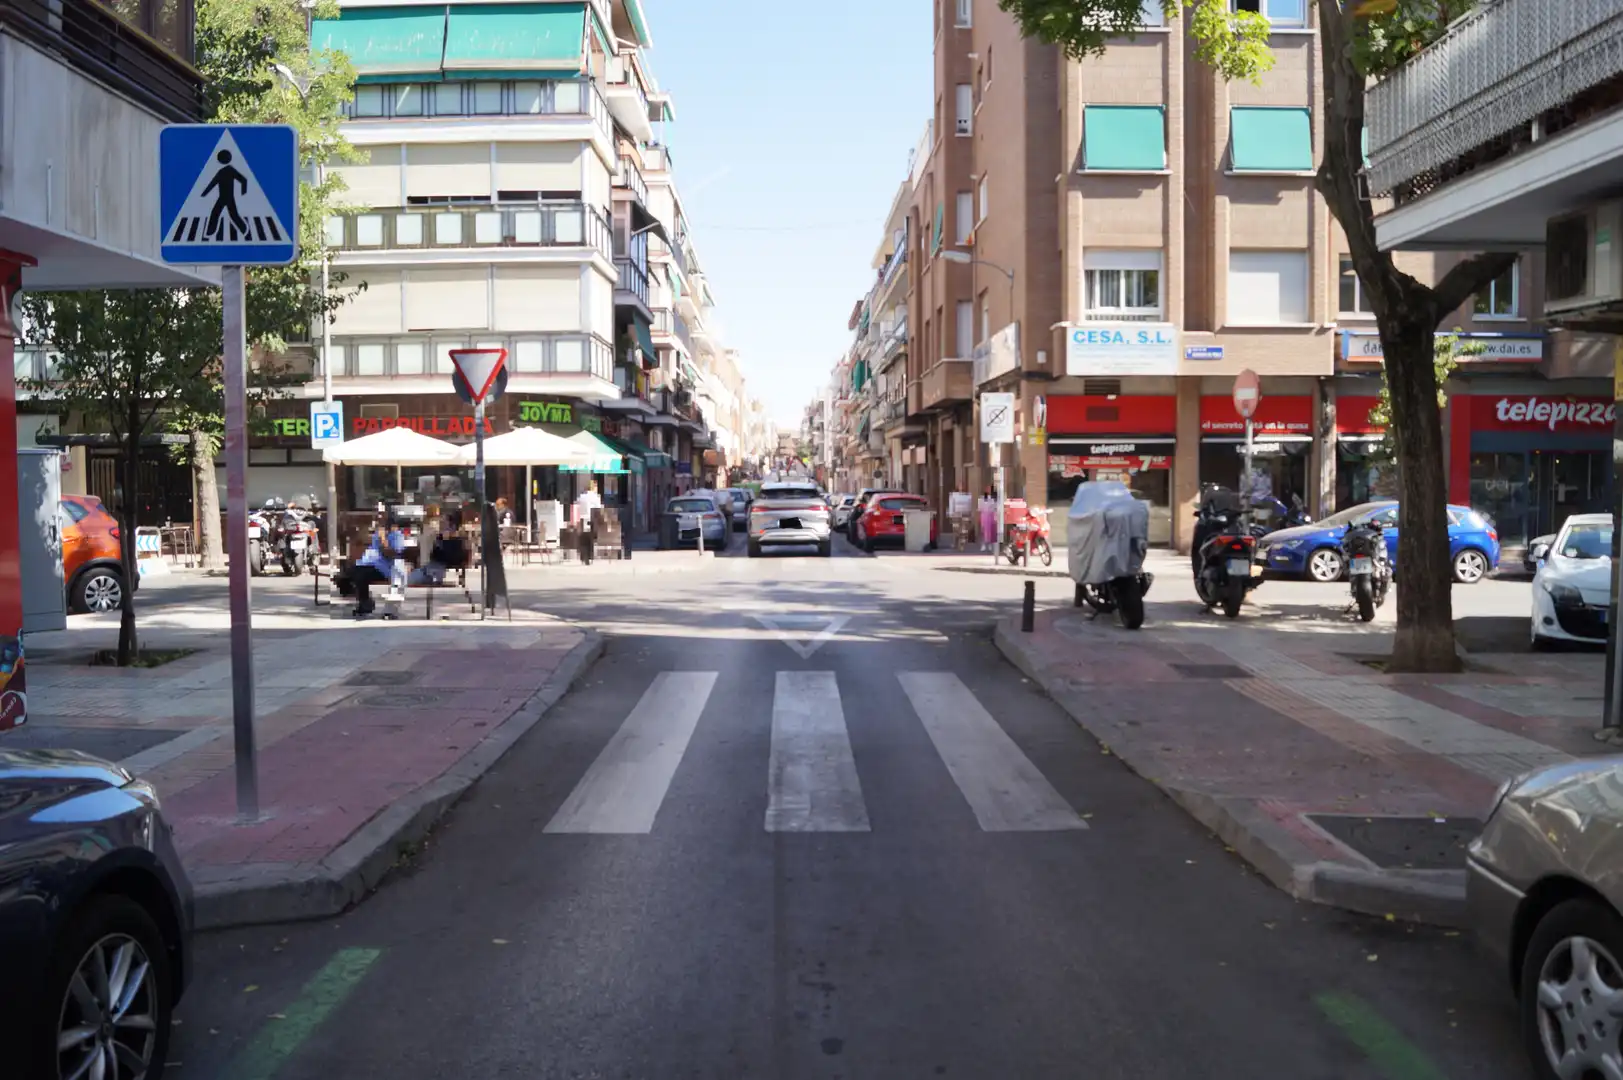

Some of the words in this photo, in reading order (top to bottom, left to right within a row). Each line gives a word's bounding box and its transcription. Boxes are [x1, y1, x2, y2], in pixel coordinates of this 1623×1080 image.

[1073, 330, 1131, 345] CESA,
[1137, 330, 1172, 344] S.L.
[519, 402, 572, 423] JOYMA
[1496, 397, 1616, 431] telepizza
